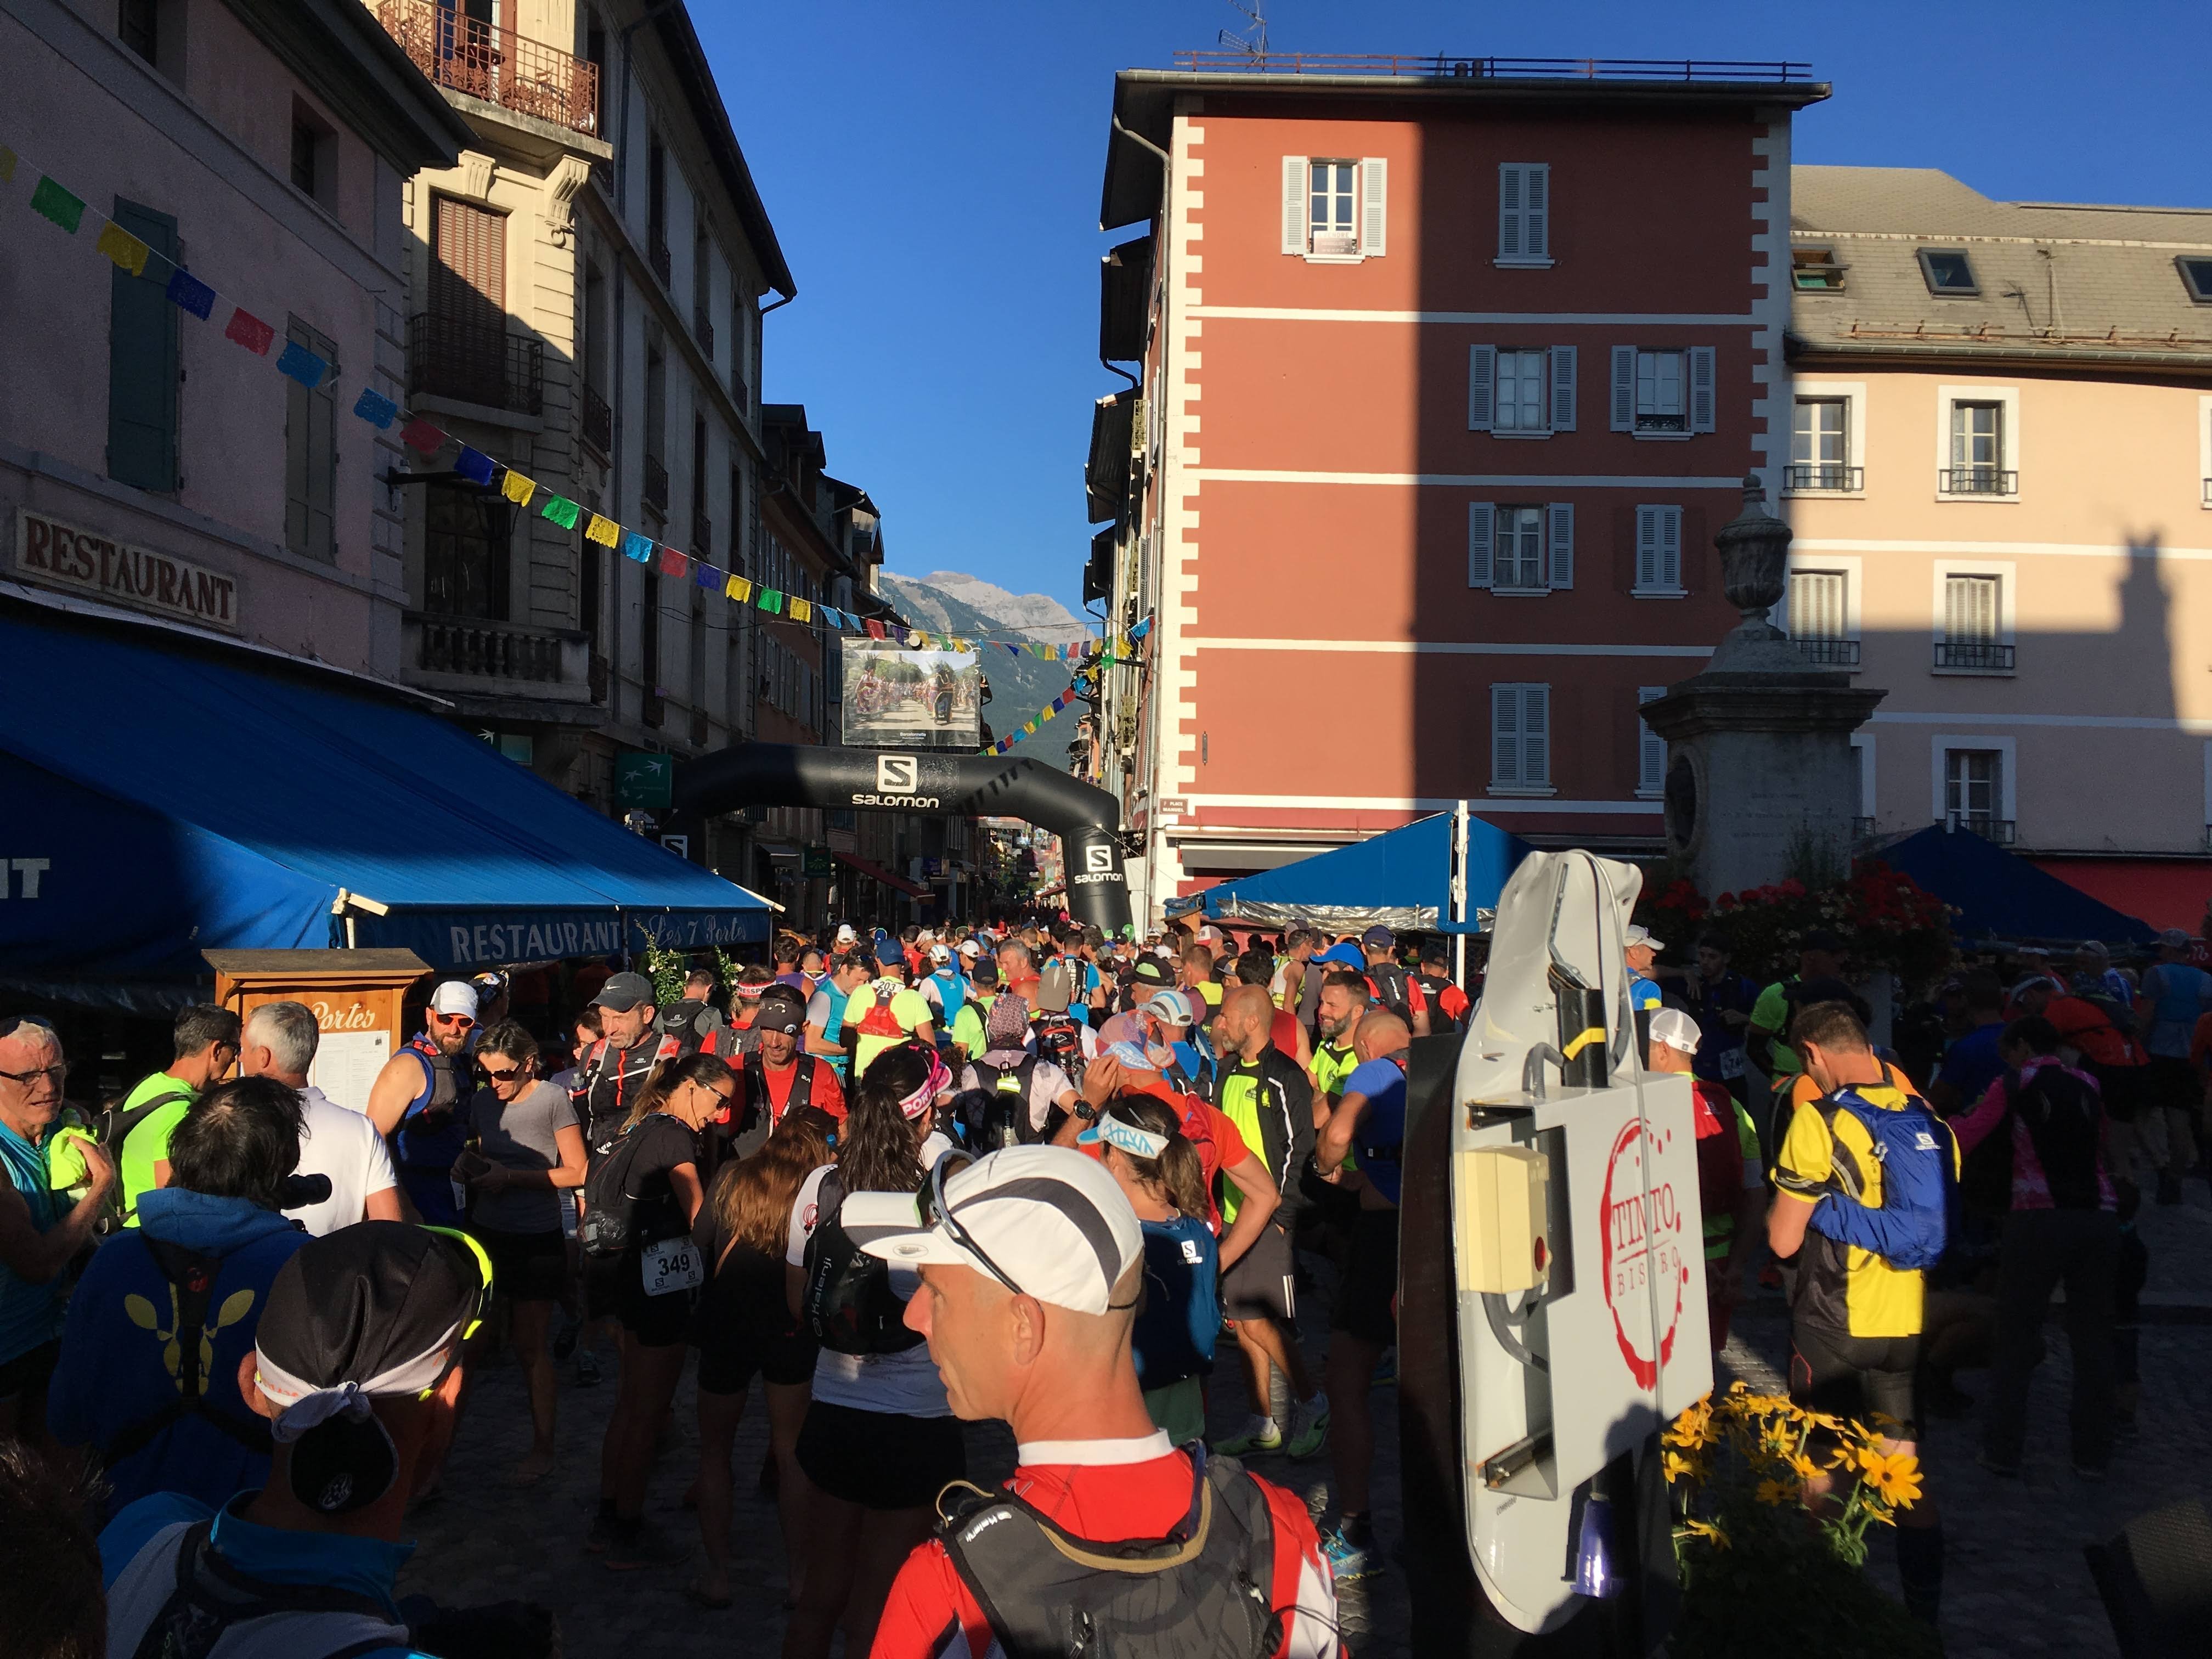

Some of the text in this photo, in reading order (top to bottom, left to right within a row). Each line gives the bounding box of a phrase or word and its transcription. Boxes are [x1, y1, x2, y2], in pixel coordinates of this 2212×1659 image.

[25, 516, 233, 619] RESTAURANT
[450, 915, 747, 963] RESTAURANT Les 7 Portes
[878, 981, 896, 991] 203
[311, 1001, 375, 1030] Portes
[1612, 1182, 1675, 1251] TINTO
[658, 1254, 690, 1277] 349
[812, 1257, 832, 1315] Kalenji
[1617, 1245, 1680, 1297] BISRO
